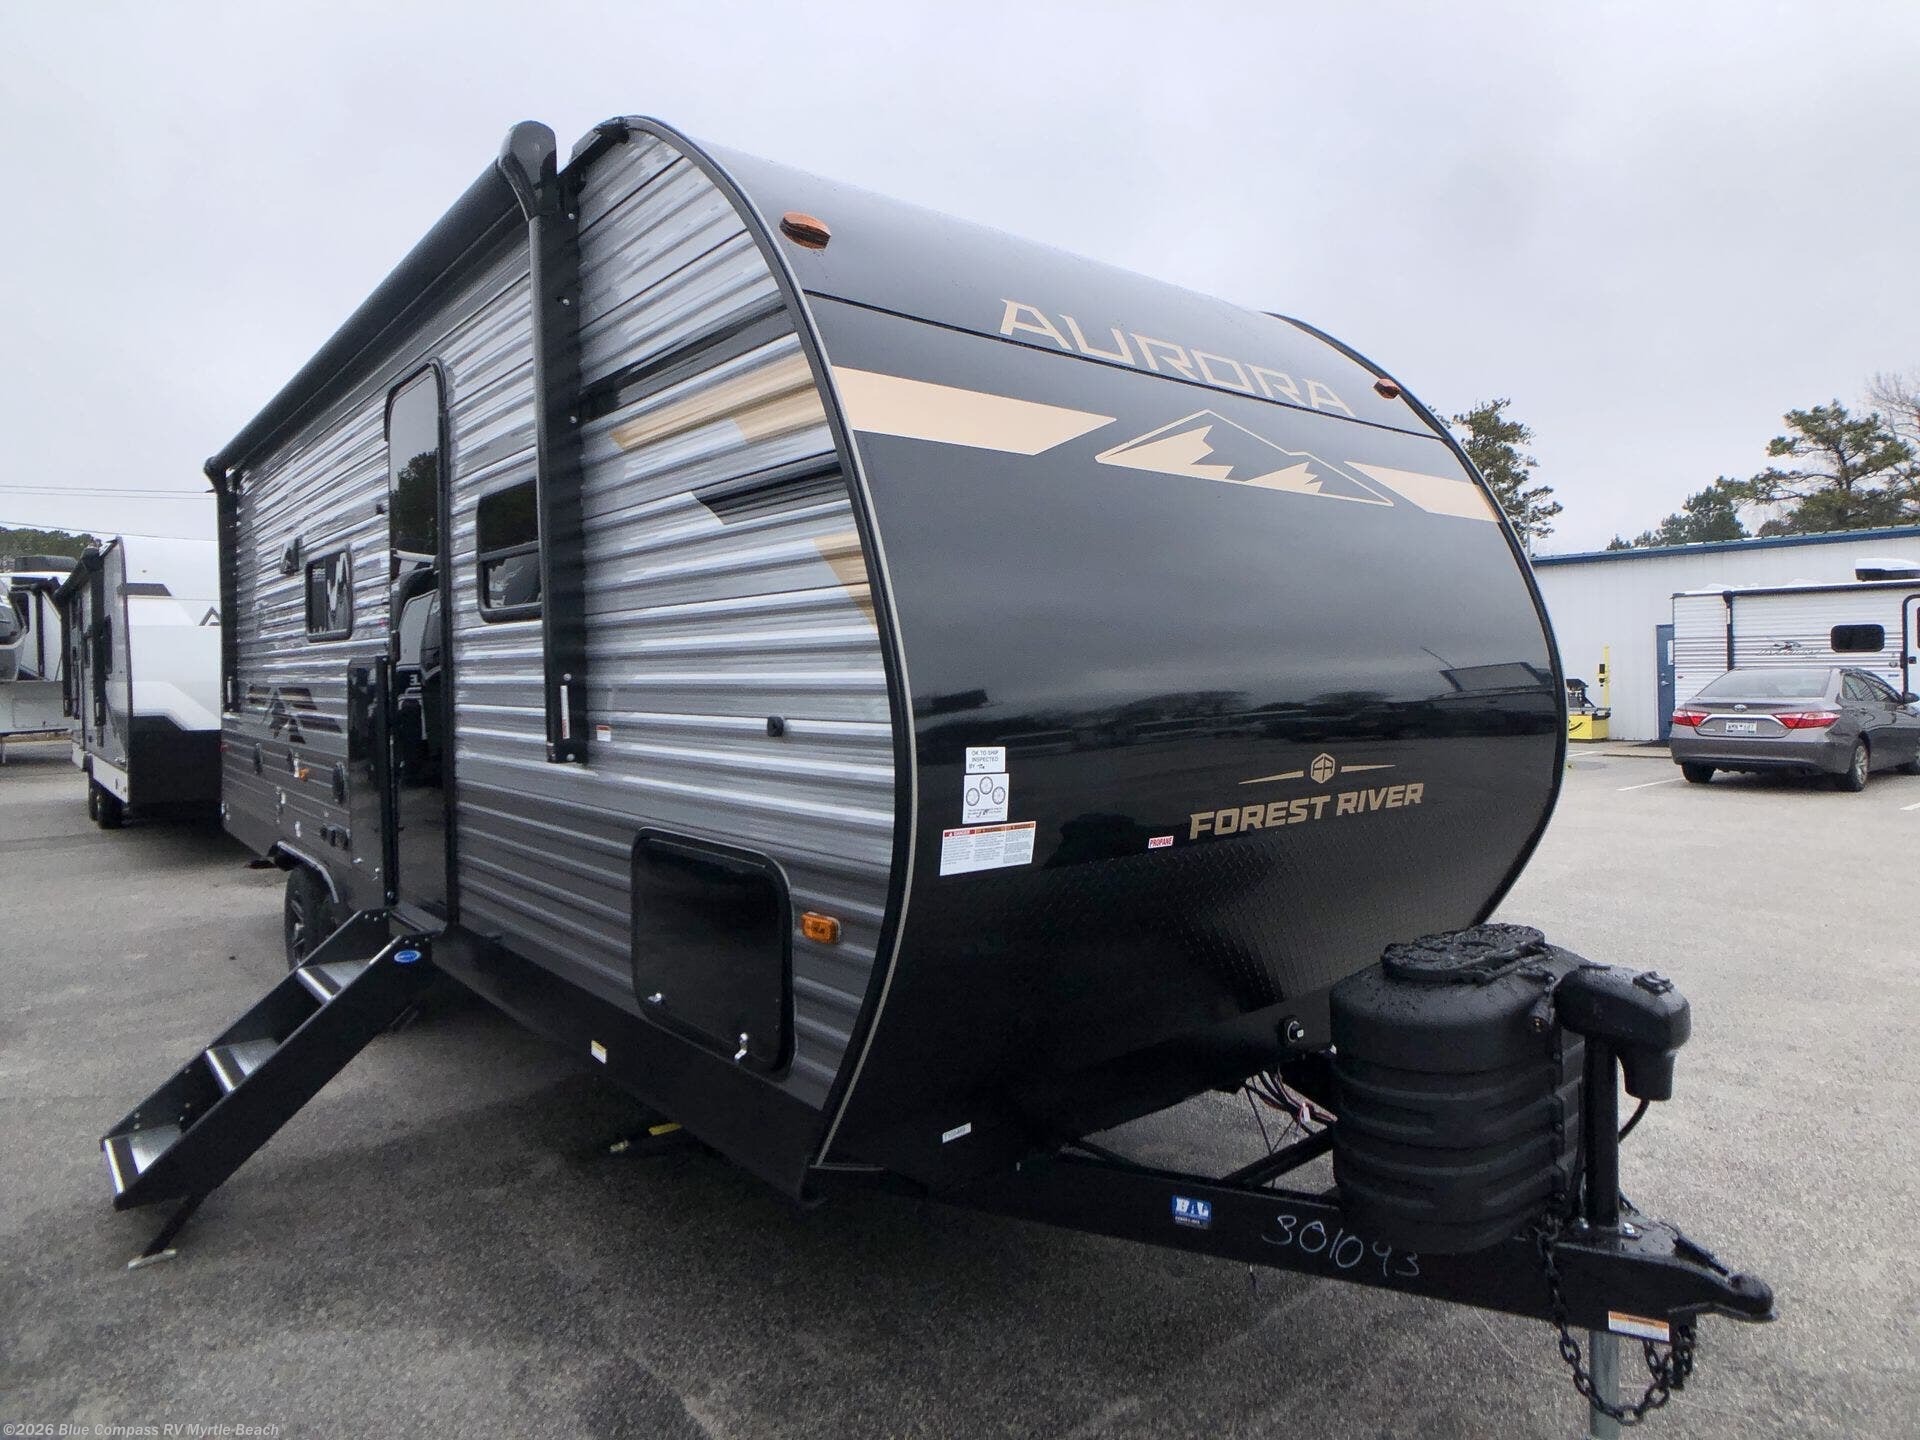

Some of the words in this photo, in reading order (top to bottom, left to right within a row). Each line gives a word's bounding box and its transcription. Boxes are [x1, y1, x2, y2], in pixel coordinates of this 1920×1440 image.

[1000, 298, 1356, 418] AURORA
[1189, 795, 1331, 840] FOREST
[1336, 783, 1424, 816] RIVER
[1150, 837, 1172, 847] PROPANE
